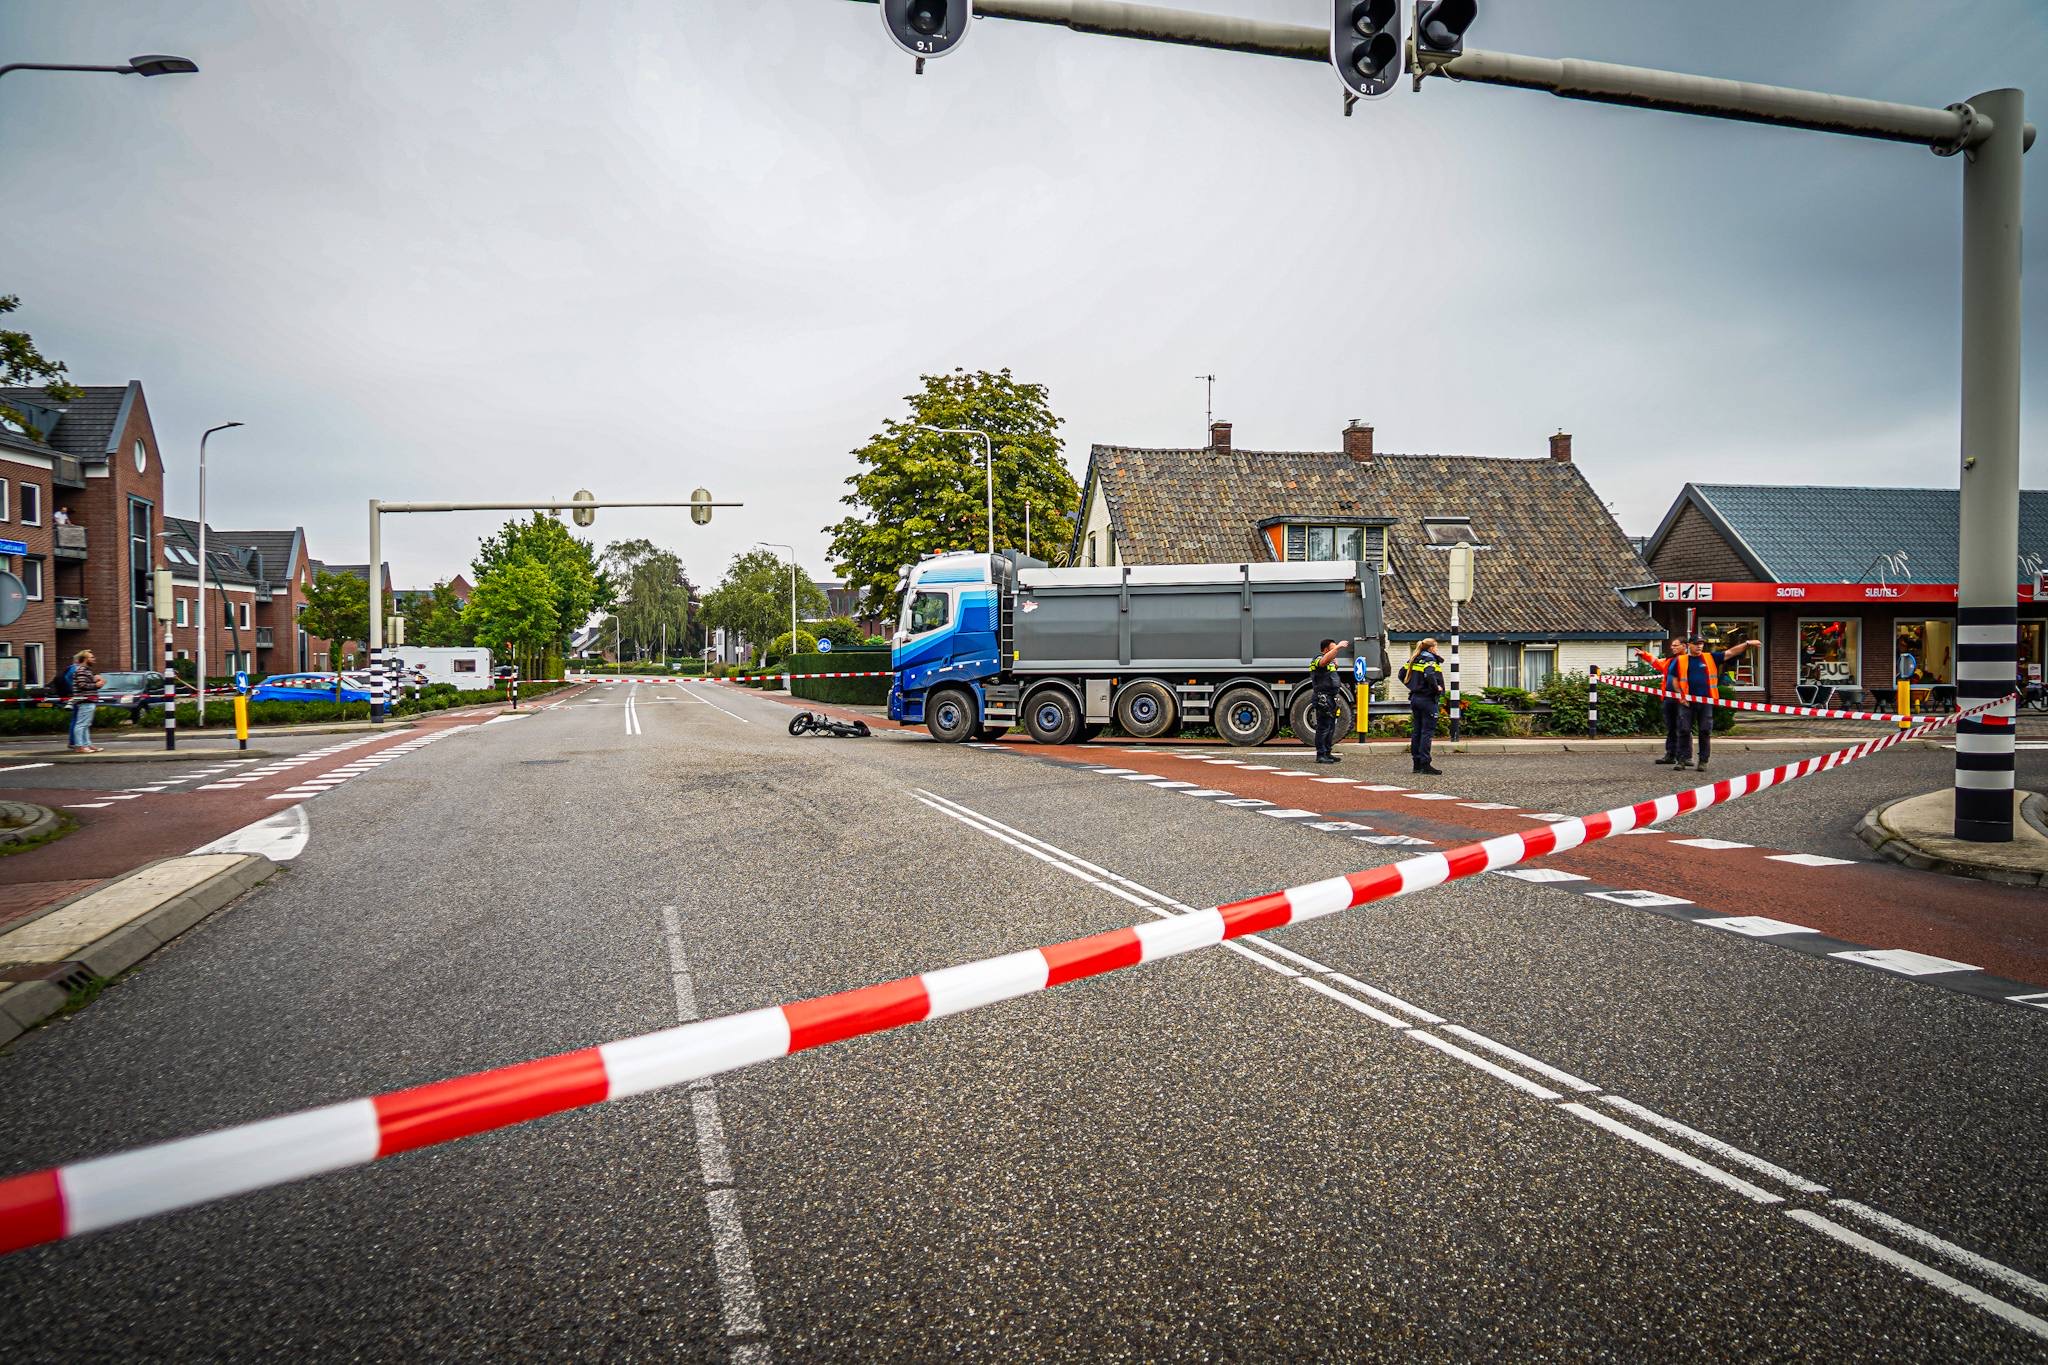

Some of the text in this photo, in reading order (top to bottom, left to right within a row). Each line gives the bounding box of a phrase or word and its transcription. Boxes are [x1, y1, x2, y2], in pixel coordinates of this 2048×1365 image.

[917, 41, 933, 52] 9.1
[1360, 83, 1374, 94] 8.1
[1776, 588, 1805, 597] SLOTEN
[1865, 588, 1898, 597] SLEUTELS
